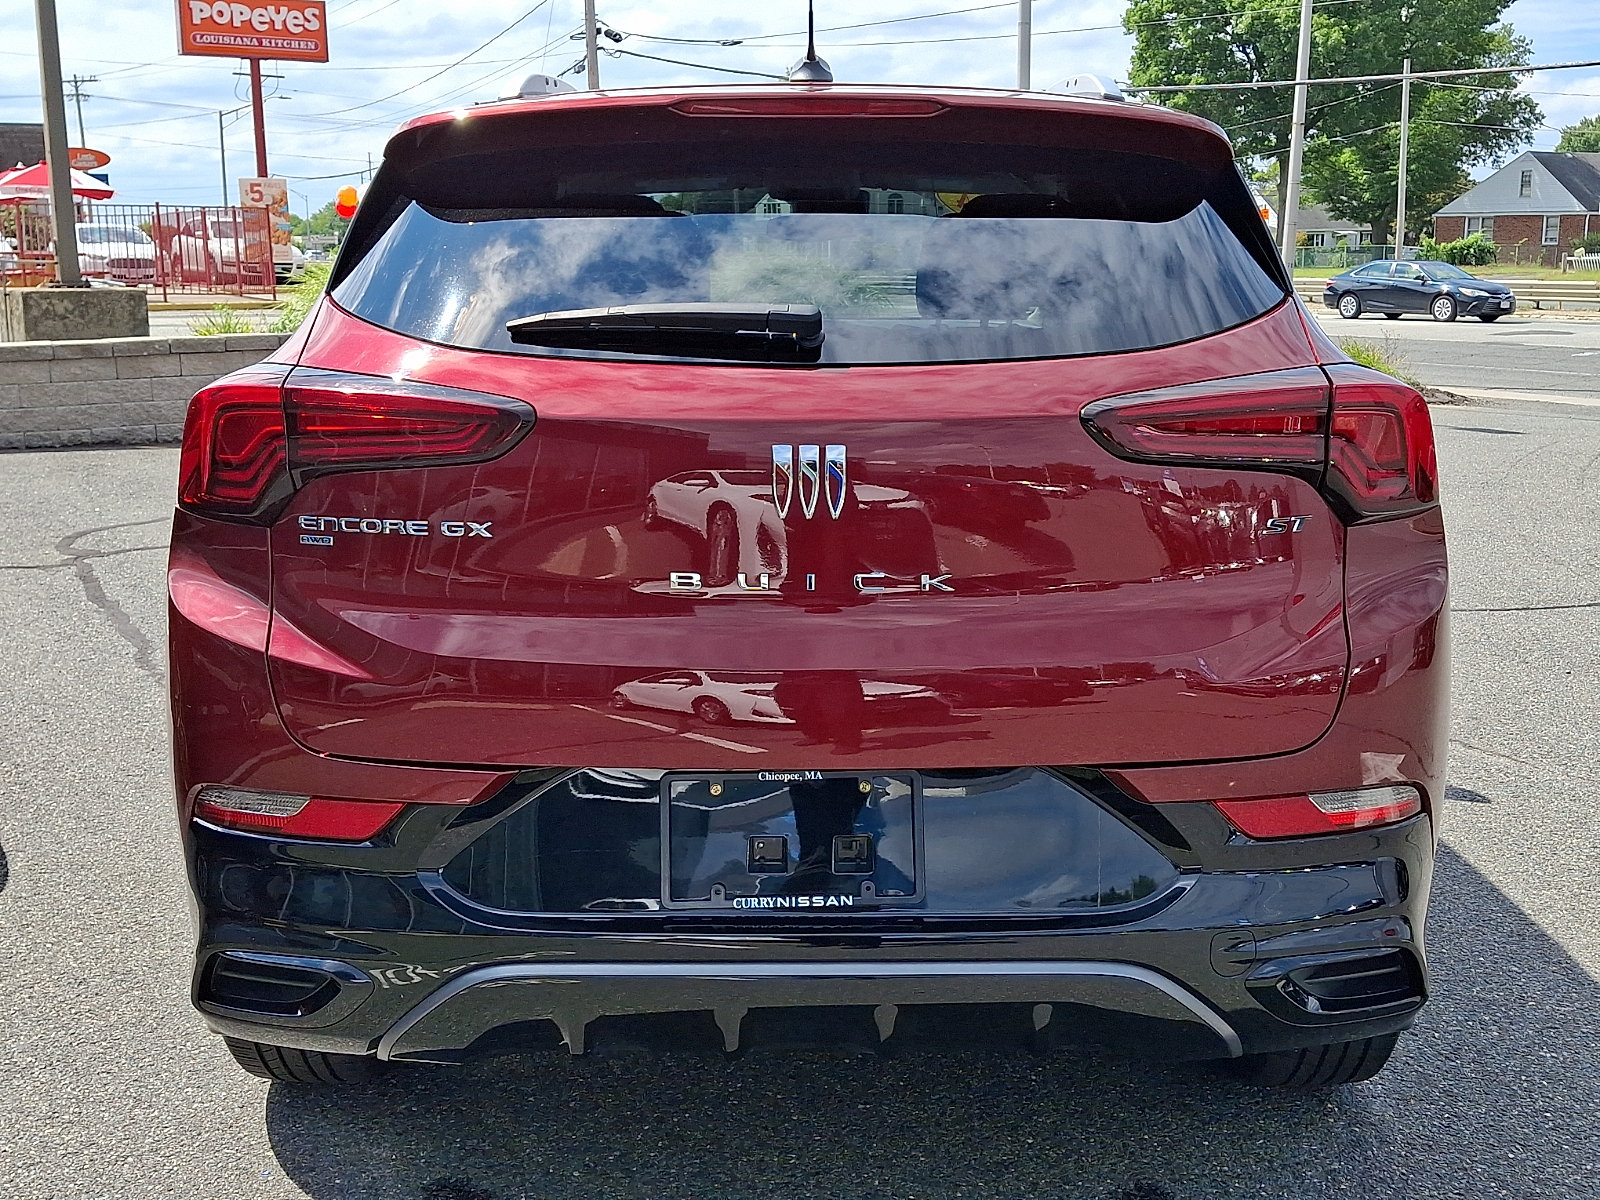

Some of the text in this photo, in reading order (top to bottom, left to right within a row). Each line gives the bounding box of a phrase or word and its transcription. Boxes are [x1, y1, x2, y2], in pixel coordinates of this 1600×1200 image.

[195, 34, 316, 50] LOUISIANA KITCHEN
[298, 515, 493, 538] ENCORE GX
[1261, 514, 1313, 535] ST
[669, 572, 955, 592] BUICK
[758, 770, 824, 783] Chicopee, MA
